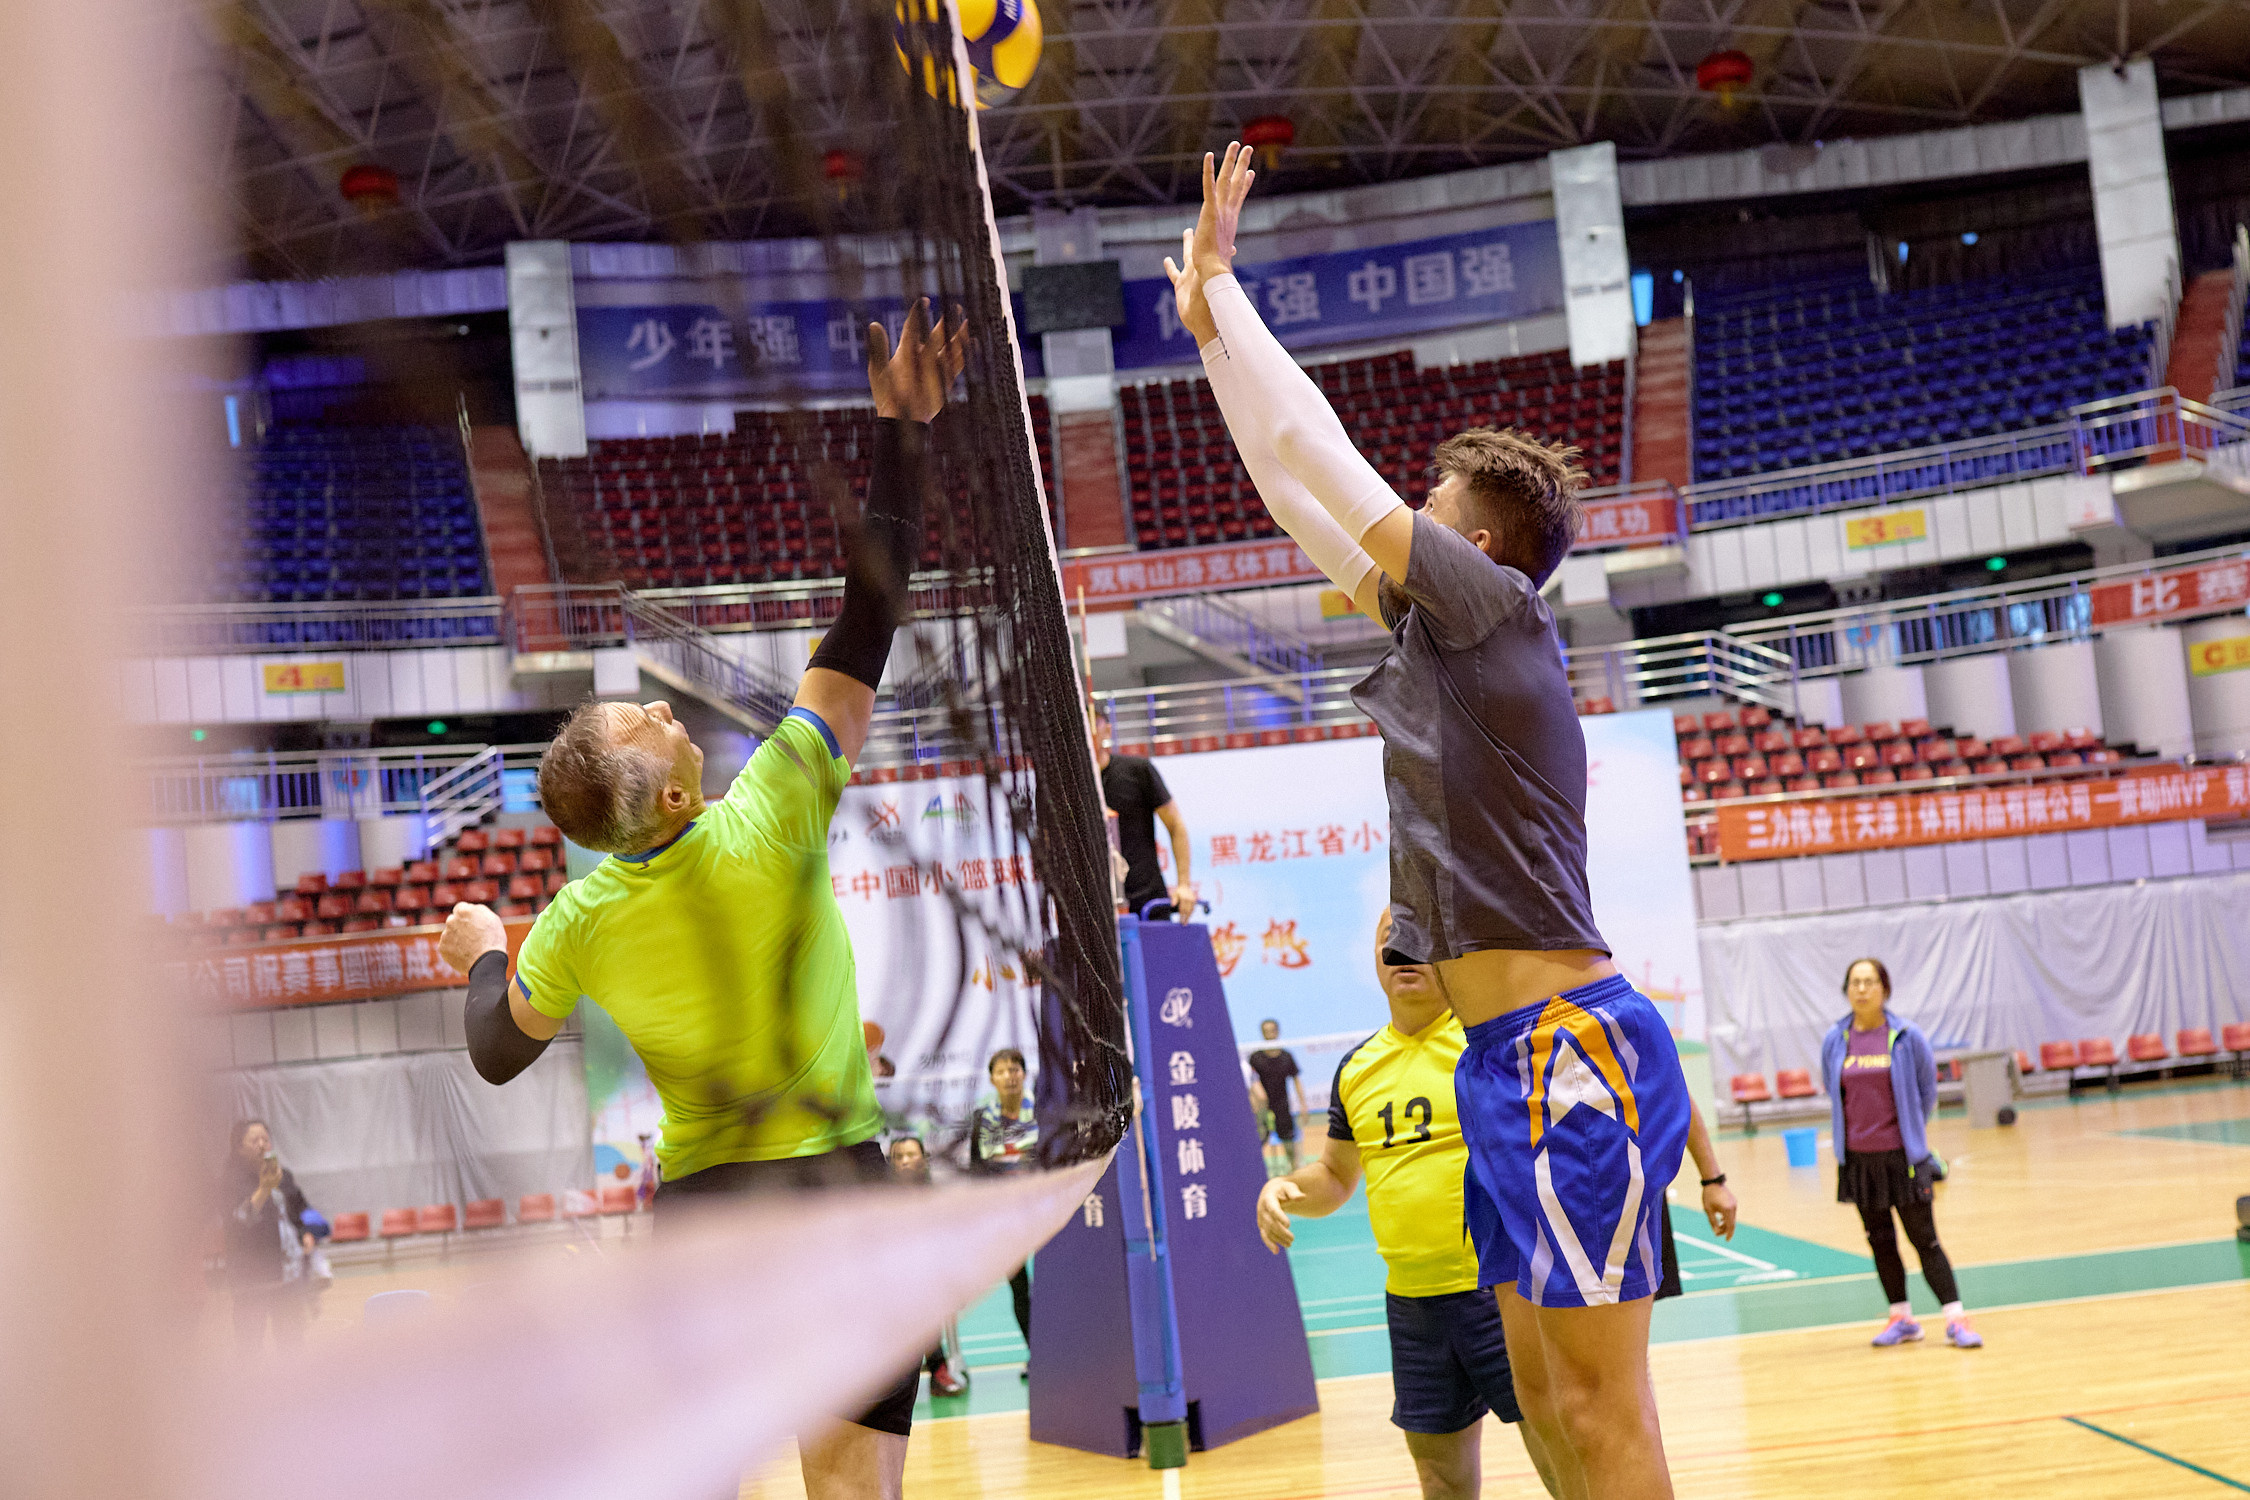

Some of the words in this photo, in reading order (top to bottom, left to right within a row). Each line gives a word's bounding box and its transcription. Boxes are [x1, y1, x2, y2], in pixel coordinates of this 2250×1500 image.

[1348, 242, 1517, 313] 中国强
[1857, 1054, 1892, 1068] YONE
[1169, 1050, 1209, 1221] 金陵体育
[1377, 1096, 1433, 1149] 13
